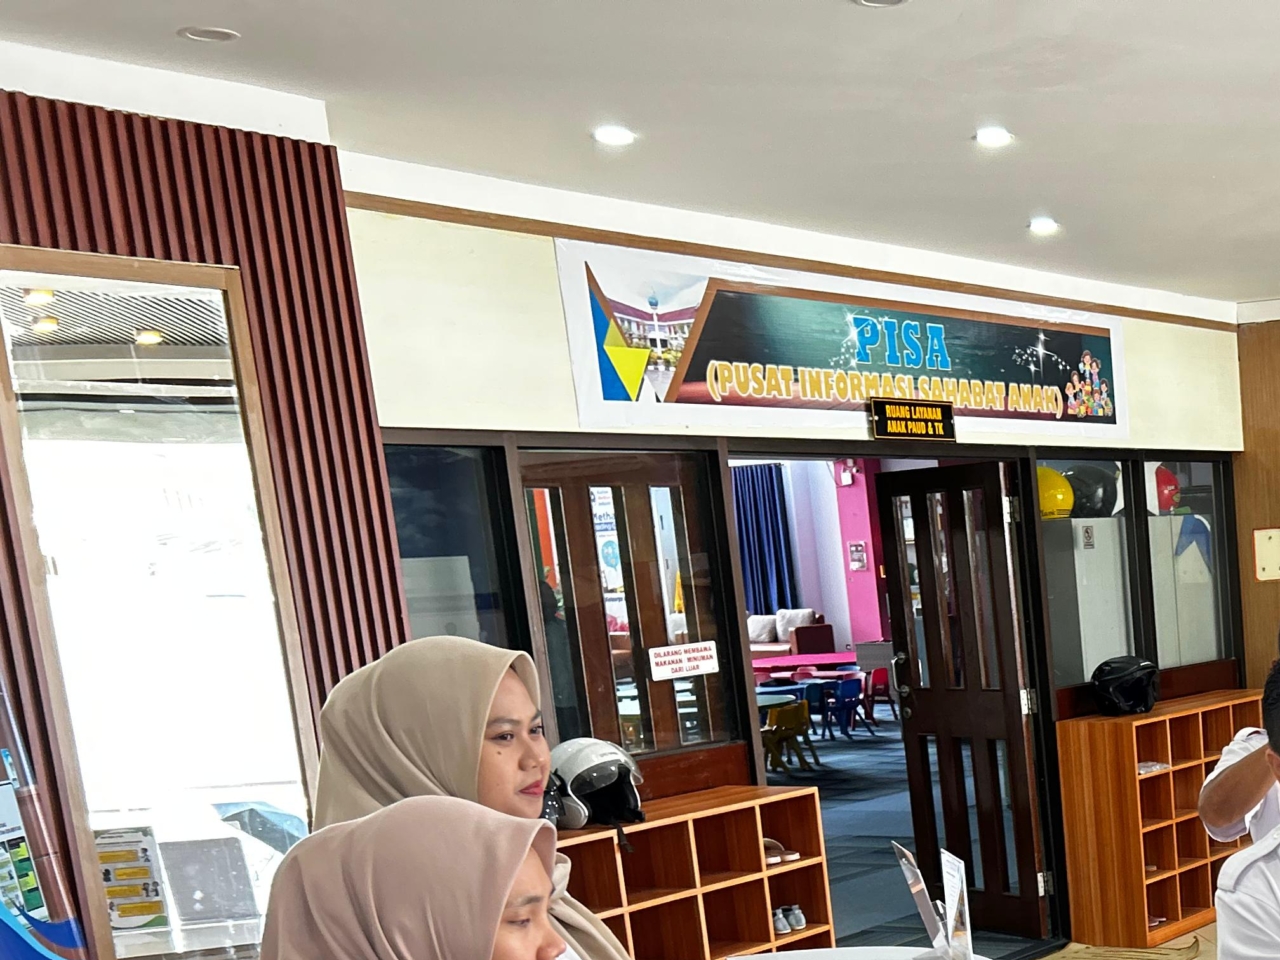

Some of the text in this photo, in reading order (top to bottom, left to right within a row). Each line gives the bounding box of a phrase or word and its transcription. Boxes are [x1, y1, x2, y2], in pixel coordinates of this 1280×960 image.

[851, 314, 951, 371] PISA
[706, 360, 1064, 419] (PUSAT INFORMASI SAHABAT ANAK)
[885, 405, 942, 420] RUANG LAYANAN
[887, 420, 944, 435] ANAK PAUD & TK
[654, 646, 712, 659] DILARANG MEMBAWA
[655, 654, 713, 667] MAKANAN MINUMAN
[671, 664, 700, 674] DARI LUAR
